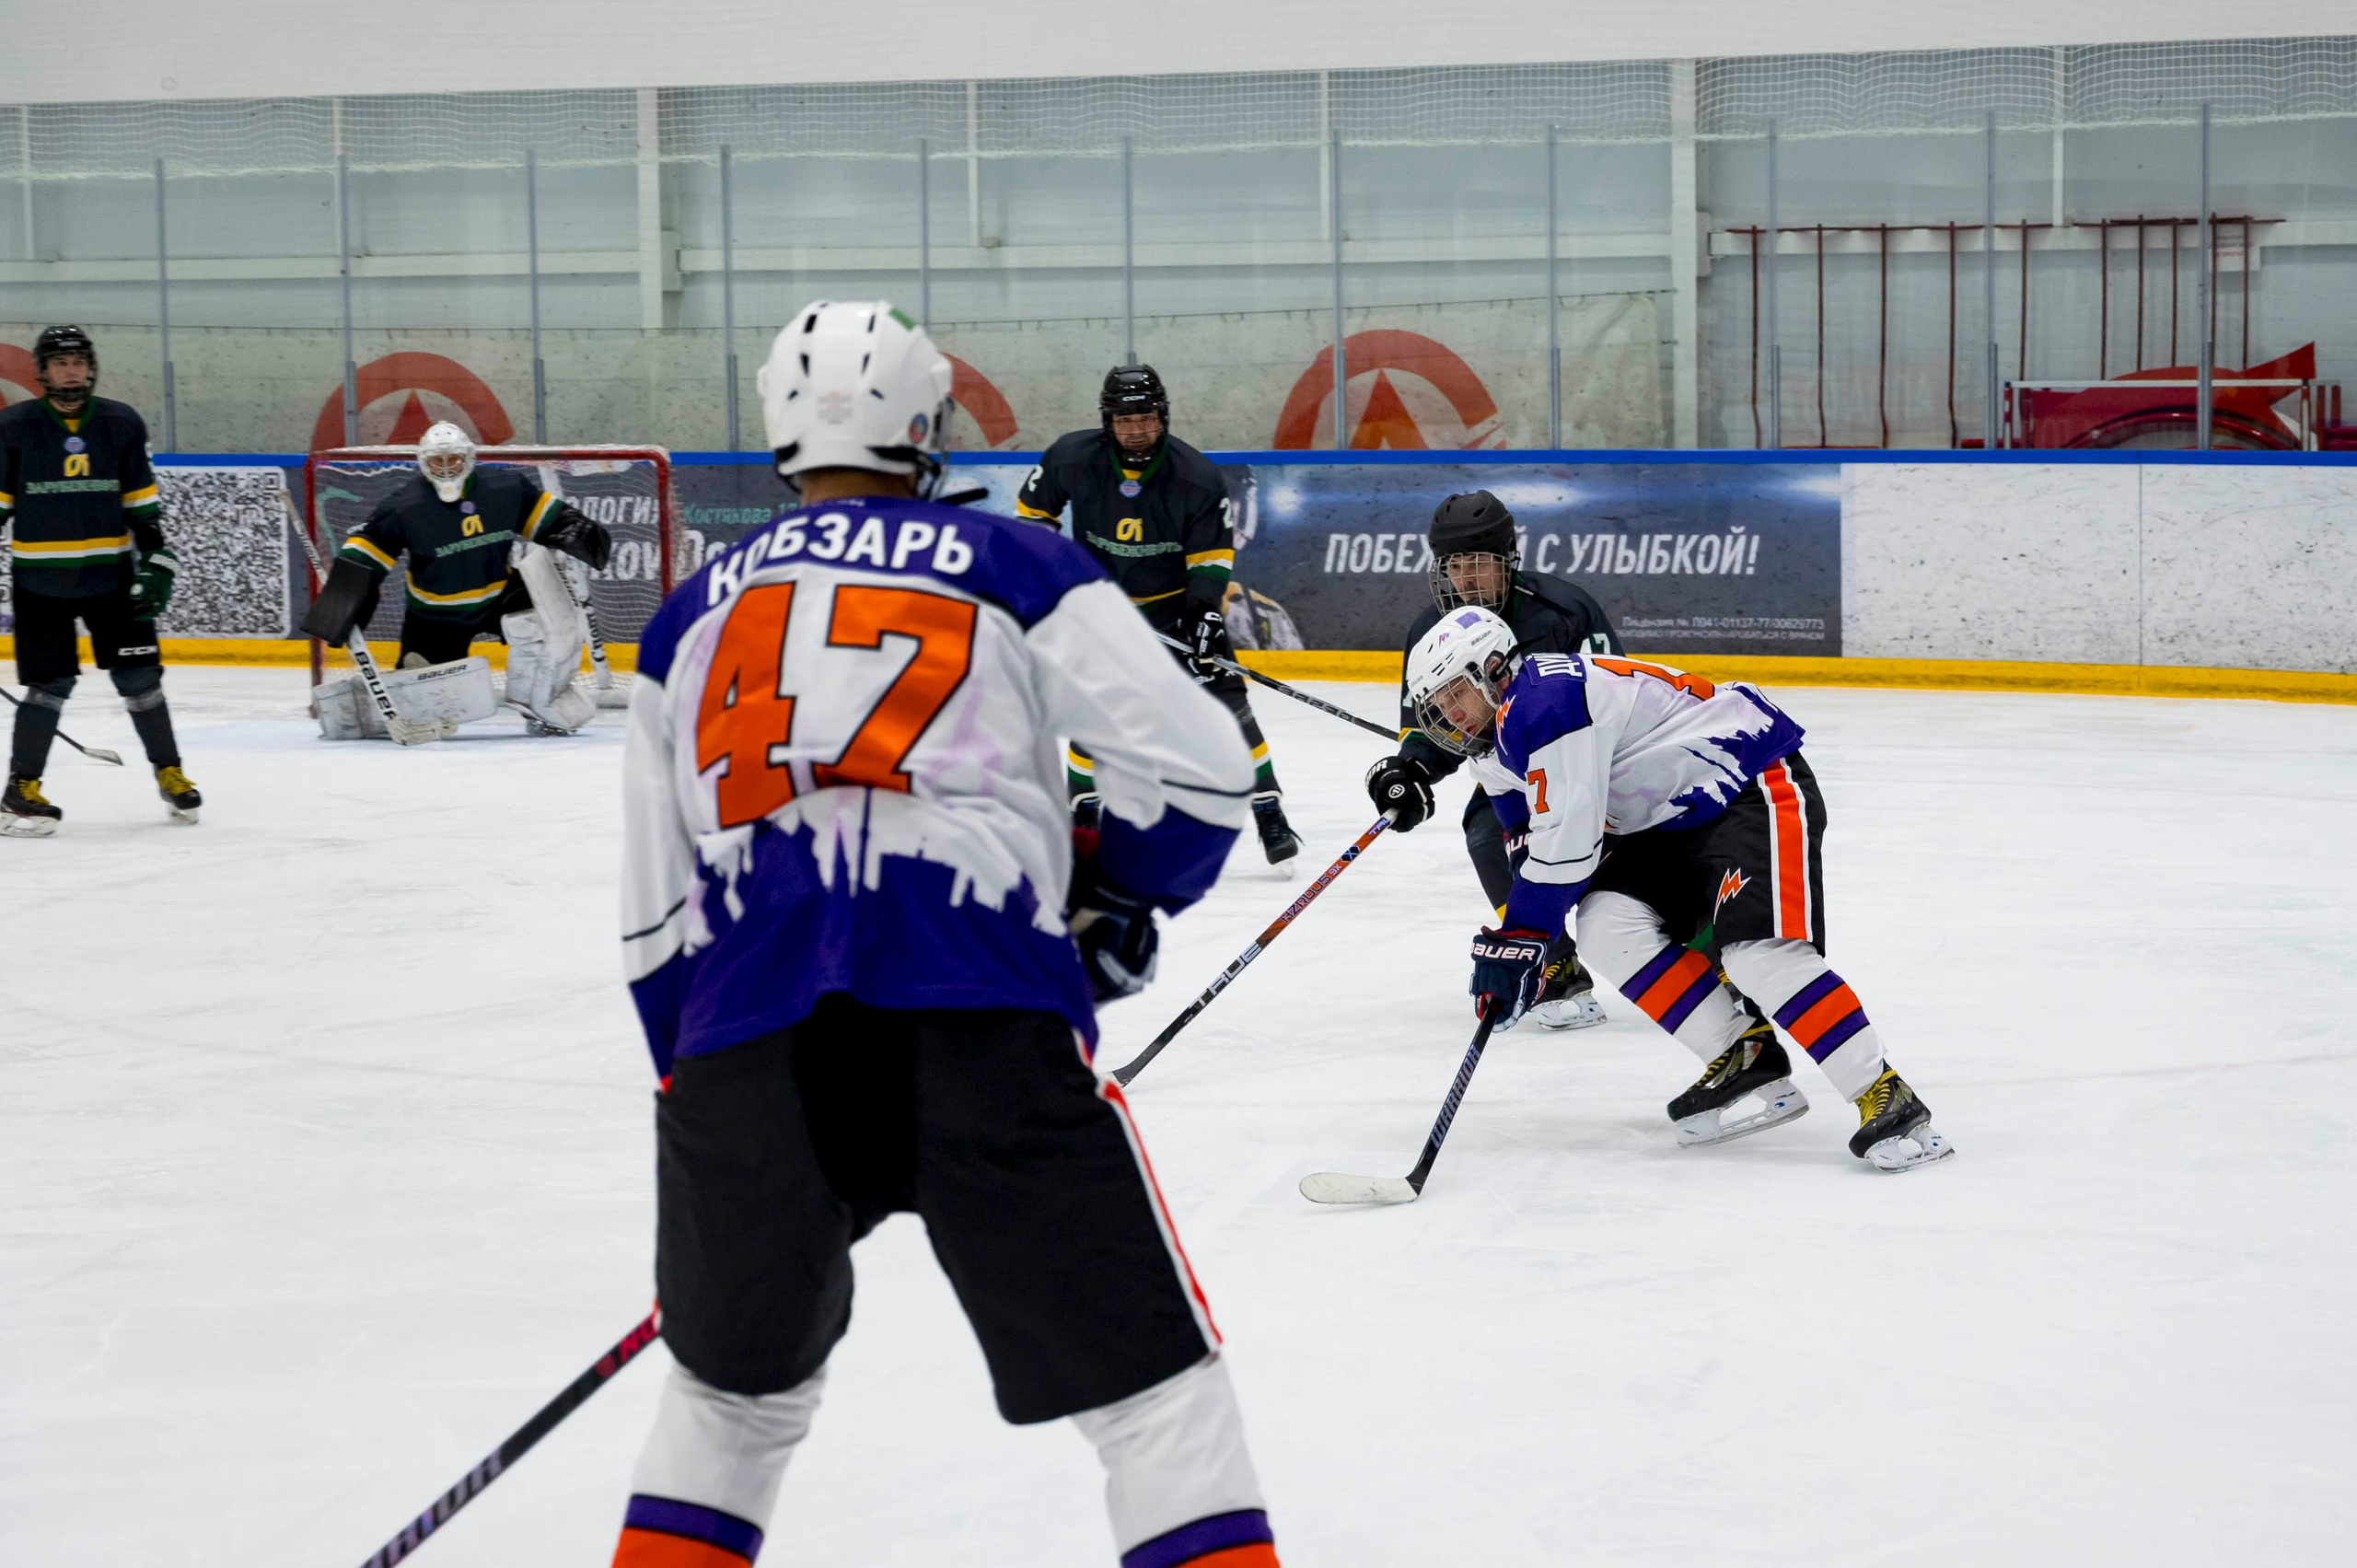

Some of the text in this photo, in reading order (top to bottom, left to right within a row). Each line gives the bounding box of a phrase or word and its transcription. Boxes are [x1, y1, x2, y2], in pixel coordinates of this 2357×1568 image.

[707, 513, 974, 608] КОБЗАРЬ
[1535, 534, 1560, 575] С
[1566, 525, 1760, 575] УЛЫБКОЙ!
[354, 651, 398, 720] BAUER
[417, 664, 468, 680] BAUER
[696, 581, 979, 830] 47
[1527, 768, 1550, 814] 7
[1189, 940, 1262, 1009] TRUE
[1430, 1043, 1481, 1150] WARRIOR
